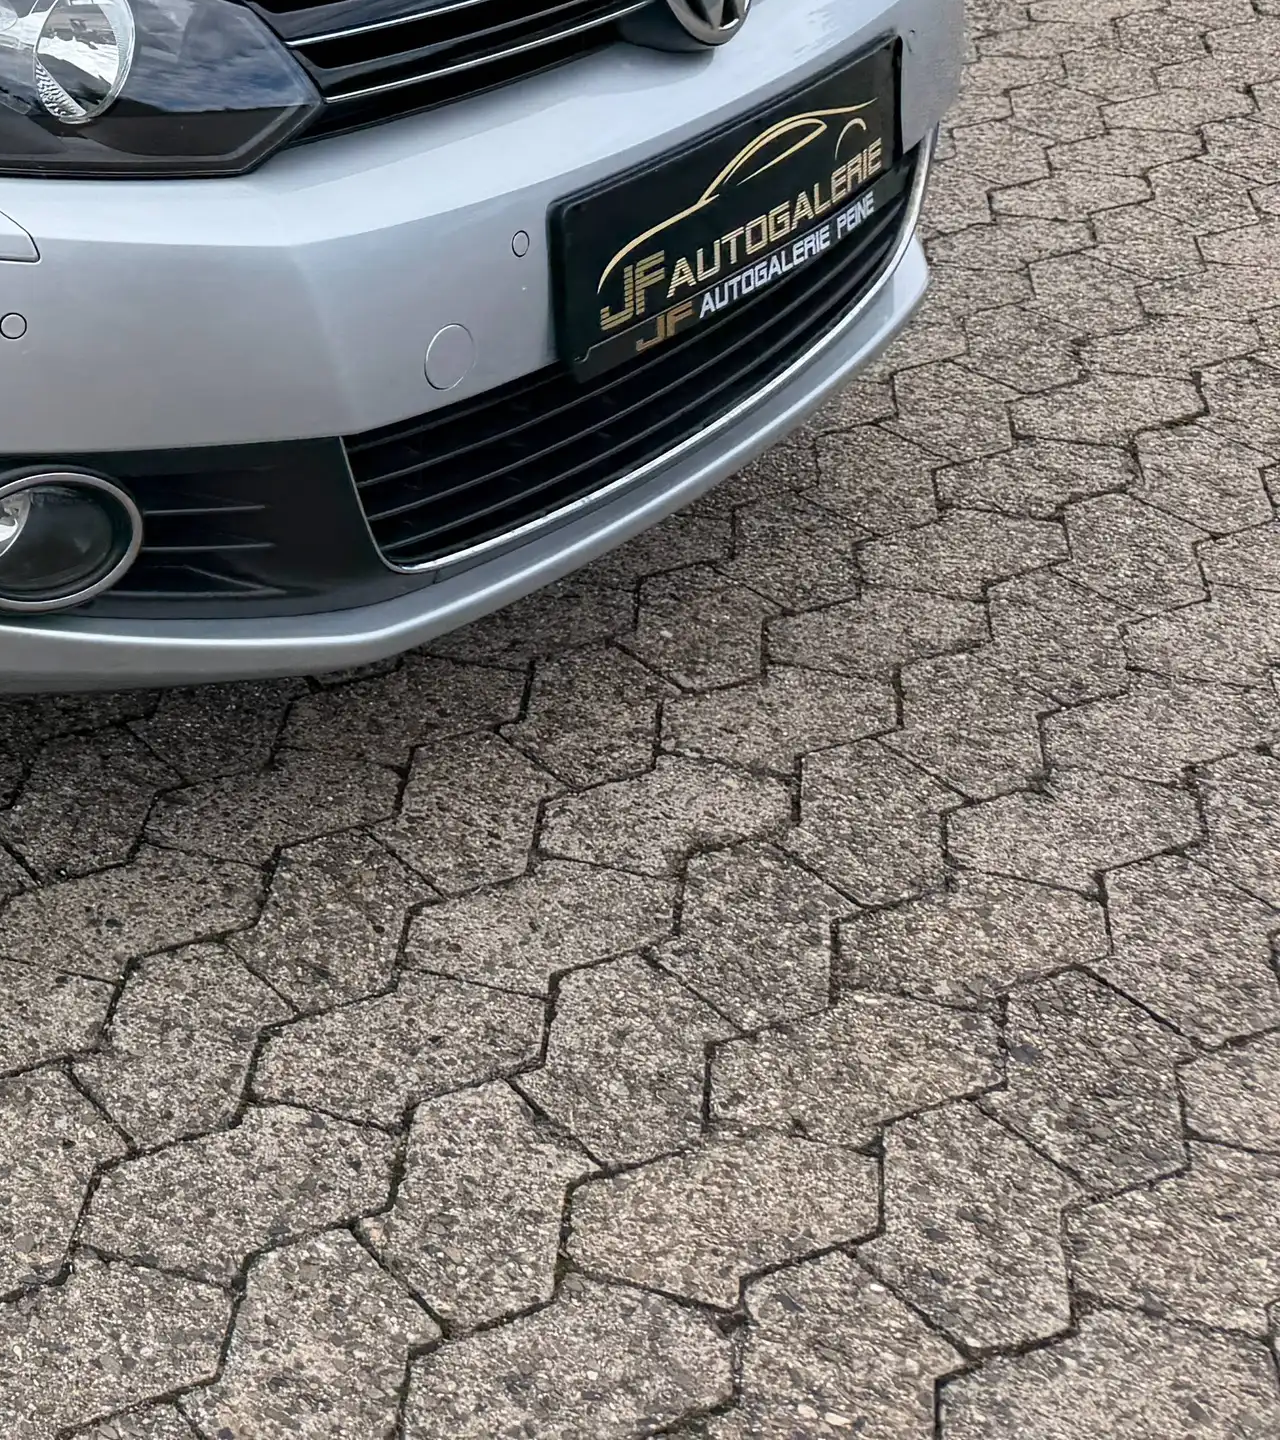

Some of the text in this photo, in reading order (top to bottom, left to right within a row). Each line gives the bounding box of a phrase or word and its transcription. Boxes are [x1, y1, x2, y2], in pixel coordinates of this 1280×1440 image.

[600, 137, 882, 331] JF AUTOGALERIE
[636, 190, 875, 352] JF AUTOGALERIE PEINE
